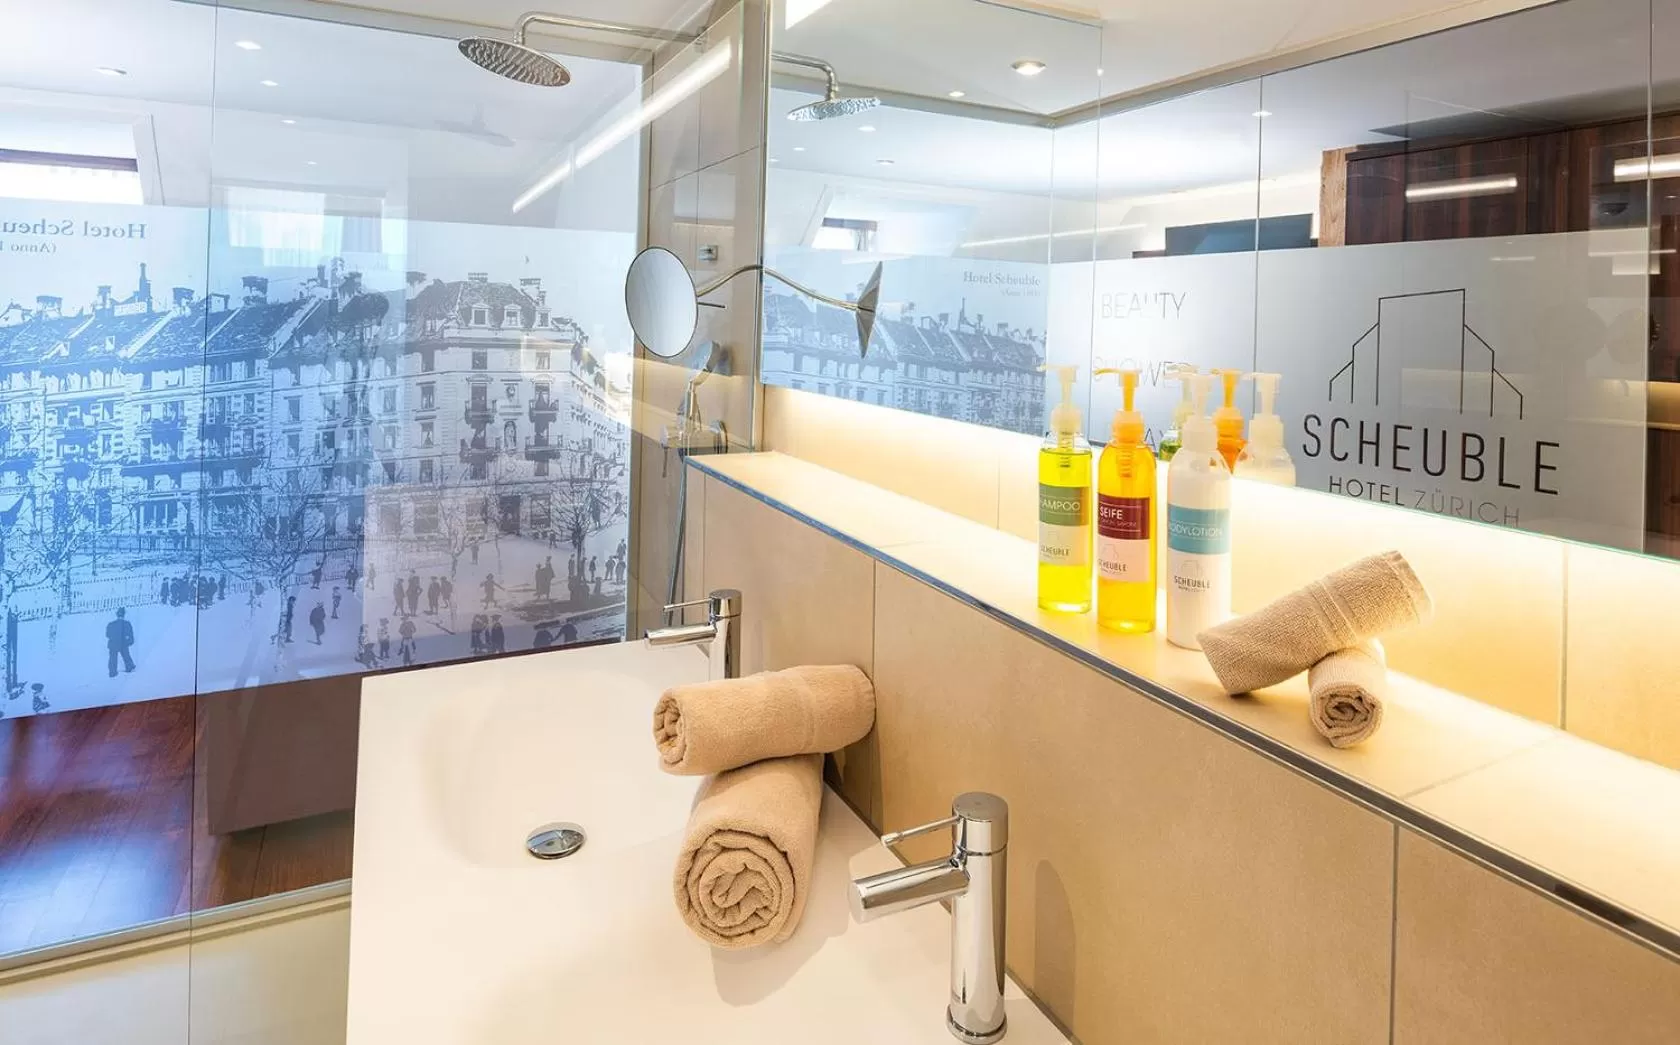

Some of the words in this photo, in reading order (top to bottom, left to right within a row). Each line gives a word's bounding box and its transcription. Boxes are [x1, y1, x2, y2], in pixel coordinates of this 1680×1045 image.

[963, 270, 992, 284] Hotel
[1302, 414, 1560, 495] SCHEUBLE
[1040, 499, 1081, 511] AMPOO
[1328, 475, 1405, 506] HOTEL
[1413, 488, 1520, 527] ZÜRICH
[1099, 506, 1123, 520] SEIFE
[1170, 521, 1224, 537] ODYLOTION
[1174, 575, 1211, 589] SCHEUBLE
